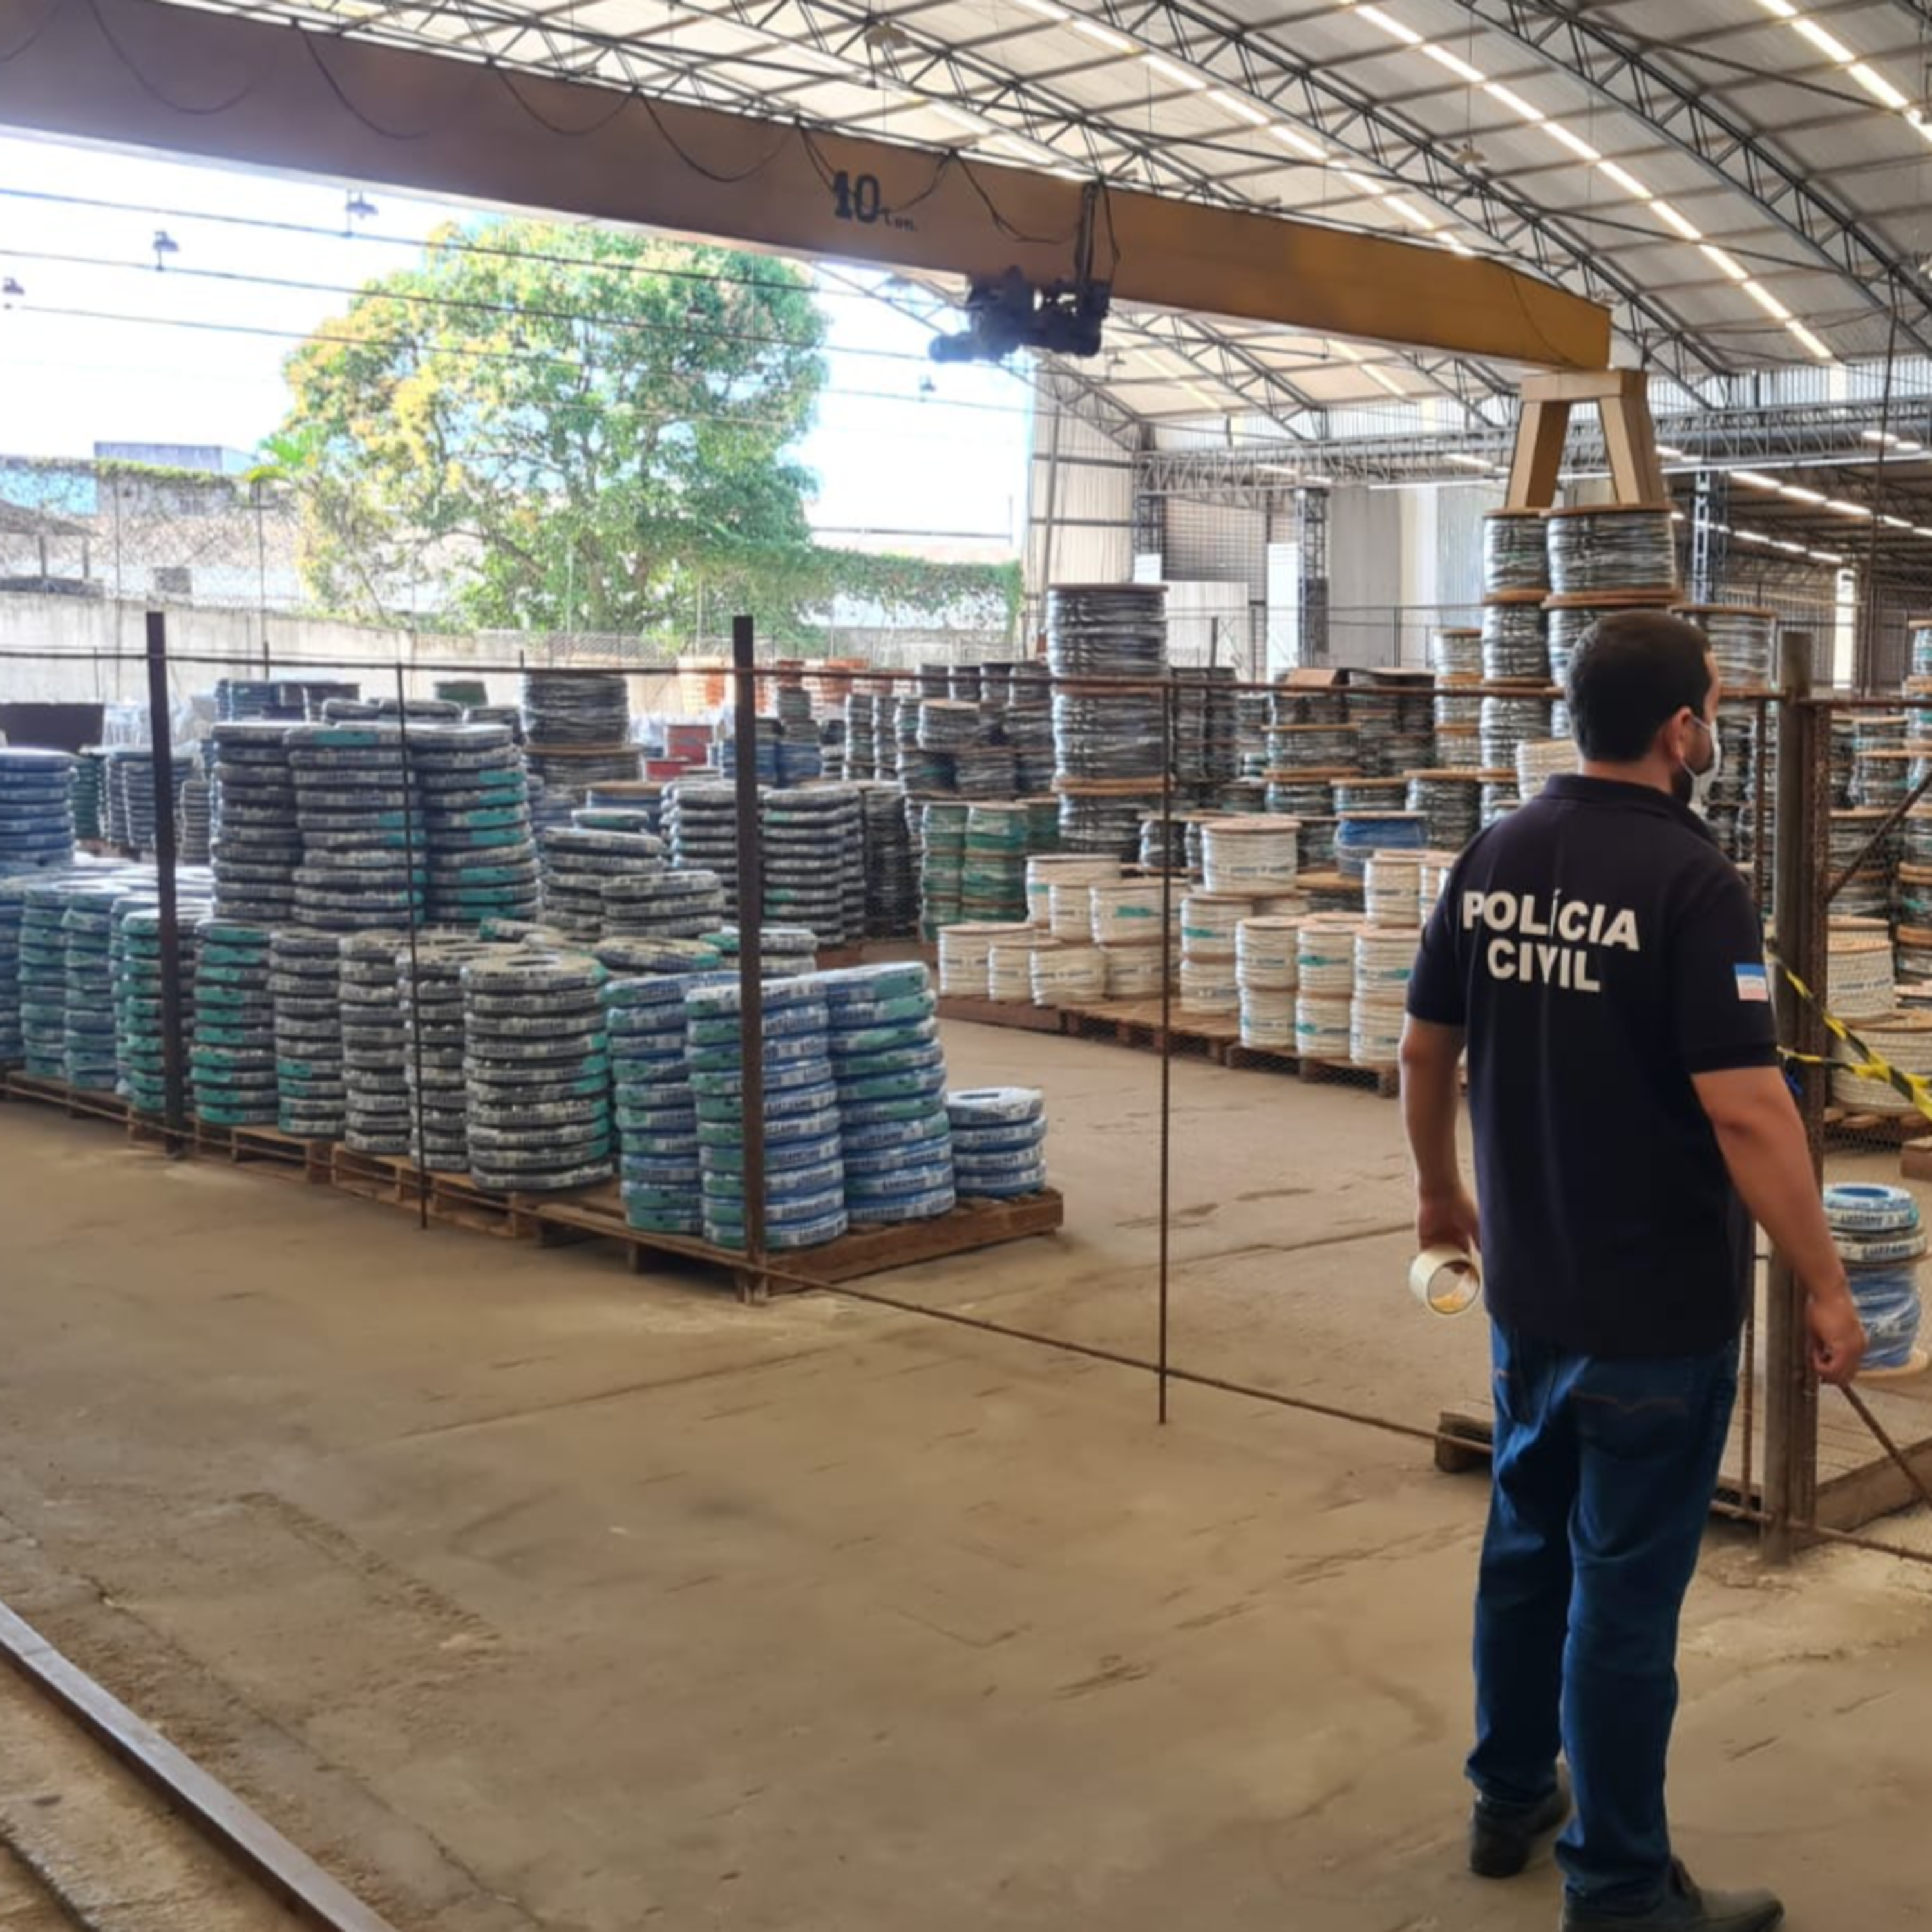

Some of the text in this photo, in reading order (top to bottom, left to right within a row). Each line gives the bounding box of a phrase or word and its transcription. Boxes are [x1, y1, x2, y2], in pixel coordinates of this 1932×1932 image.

[833, 171, 880, 223] 10
[1463, 888, 1640, 951] POLÍCIA
[1487, 938, 1601, 992] CIVIL
